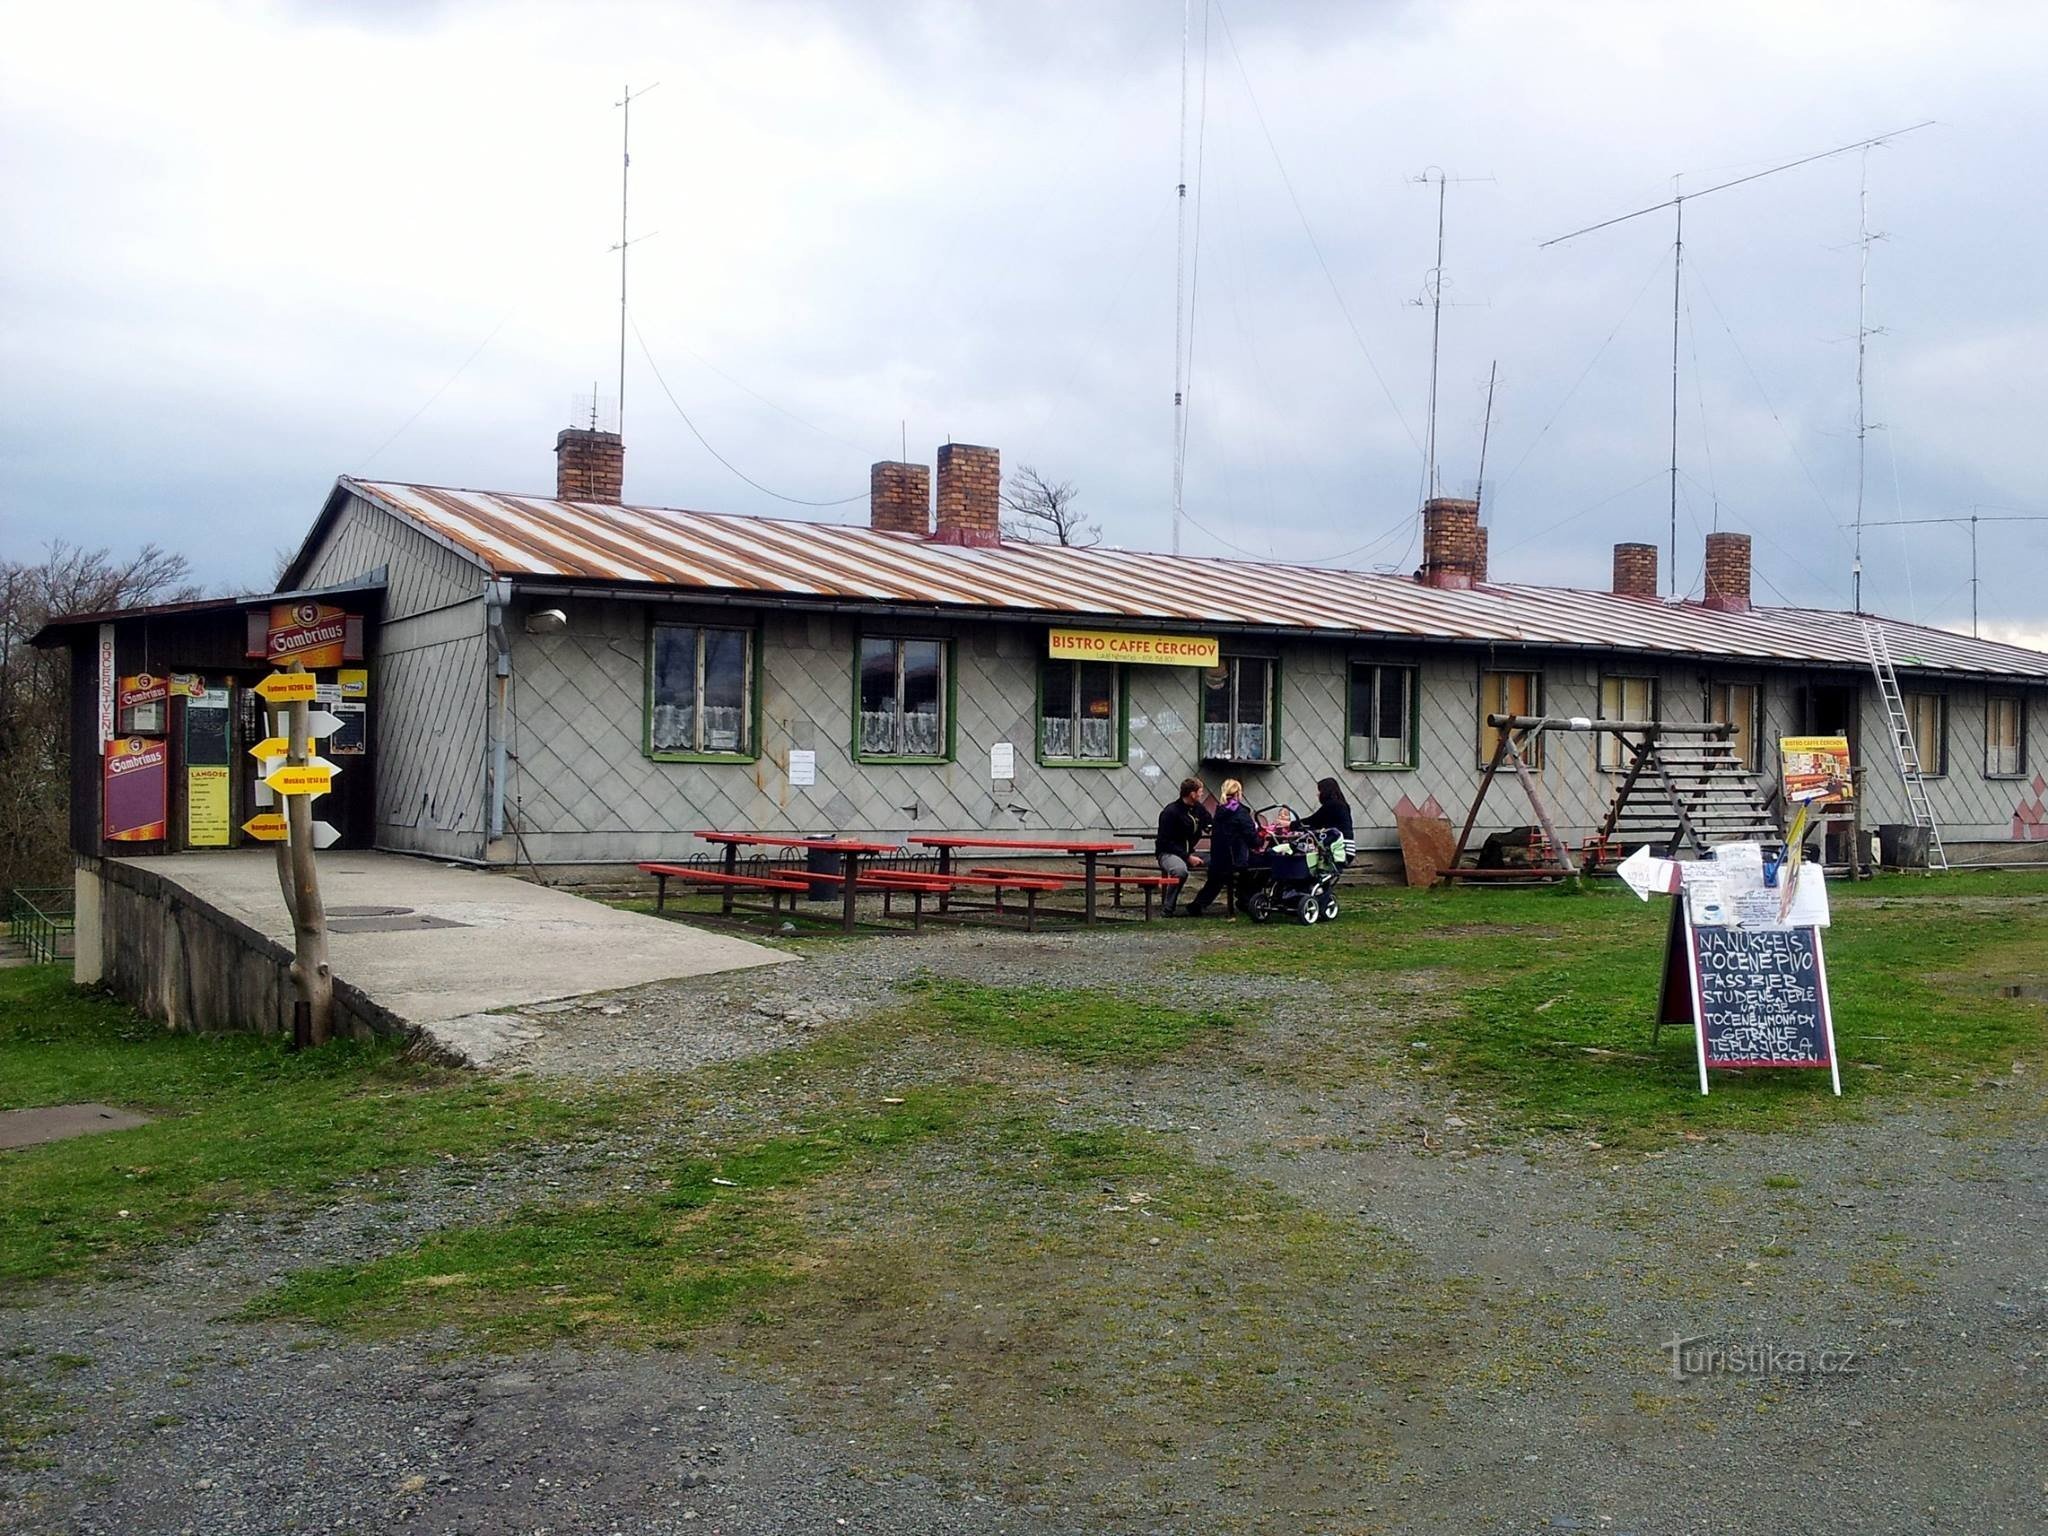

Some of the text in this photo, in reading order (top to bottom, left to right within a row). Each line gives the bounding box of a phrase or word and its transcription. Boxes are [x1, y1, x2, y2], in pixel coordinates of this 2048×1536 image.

[270, 625, 344, 652] Gambrinus
[1052, 636, 1216, 657] BISTRO CAFFE ČERCHOV
[123, 686, 166, 704] Gambrinus
[110, 751, 162, 773] Gambrinus
[1773, 950, 1813, 974] PIVO
[1701, 973, 1804, 990] FASS BIER
